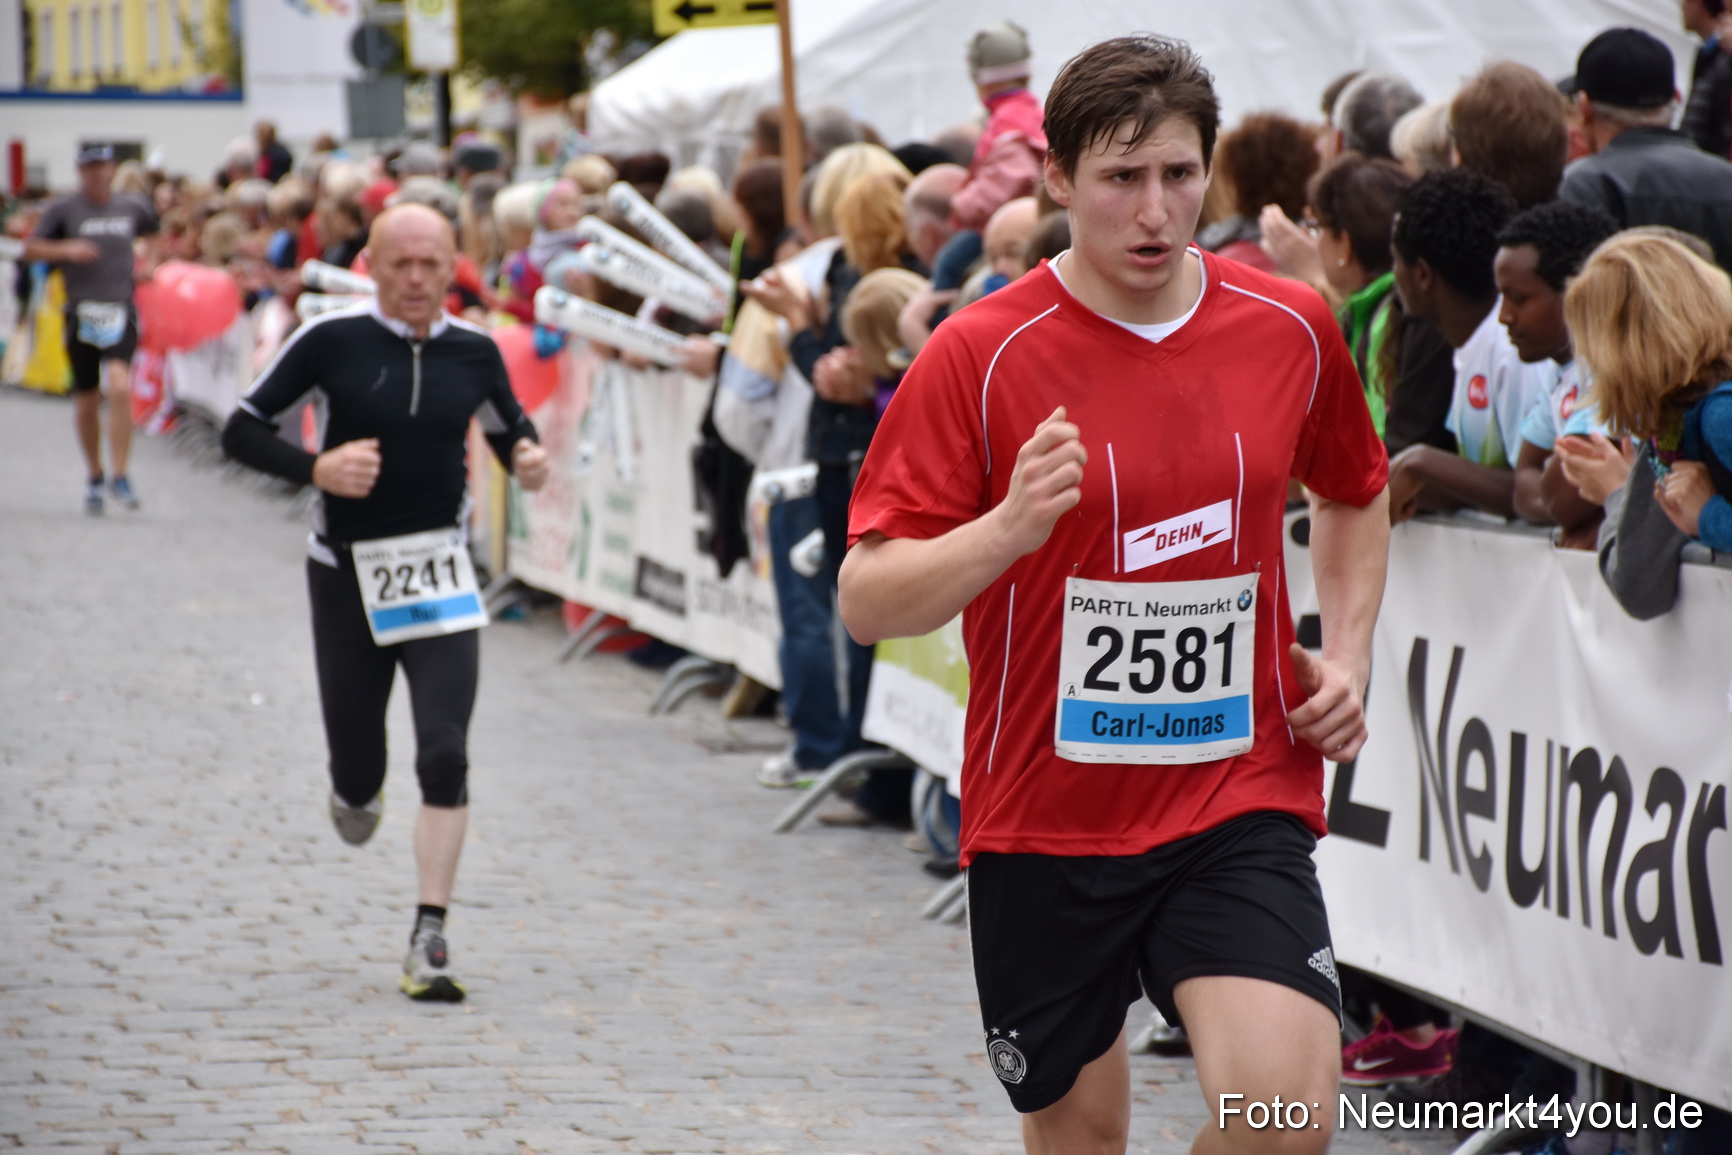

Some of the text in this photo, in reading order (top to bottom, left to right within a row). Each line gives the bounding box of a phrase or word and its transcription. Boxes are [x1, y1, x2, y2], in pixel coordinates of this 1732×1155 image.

[1155, 520, 1204, 551] DEHN
[373, 553, 459, 601] 2241
[1071, 596, 1232, 617] PARTL Neumarkt
[1083, 622, 1236, 694] 2581
[1067, 685, 1076, 697] A
[1091, 711, 1225, 738] Carl-Jonas
